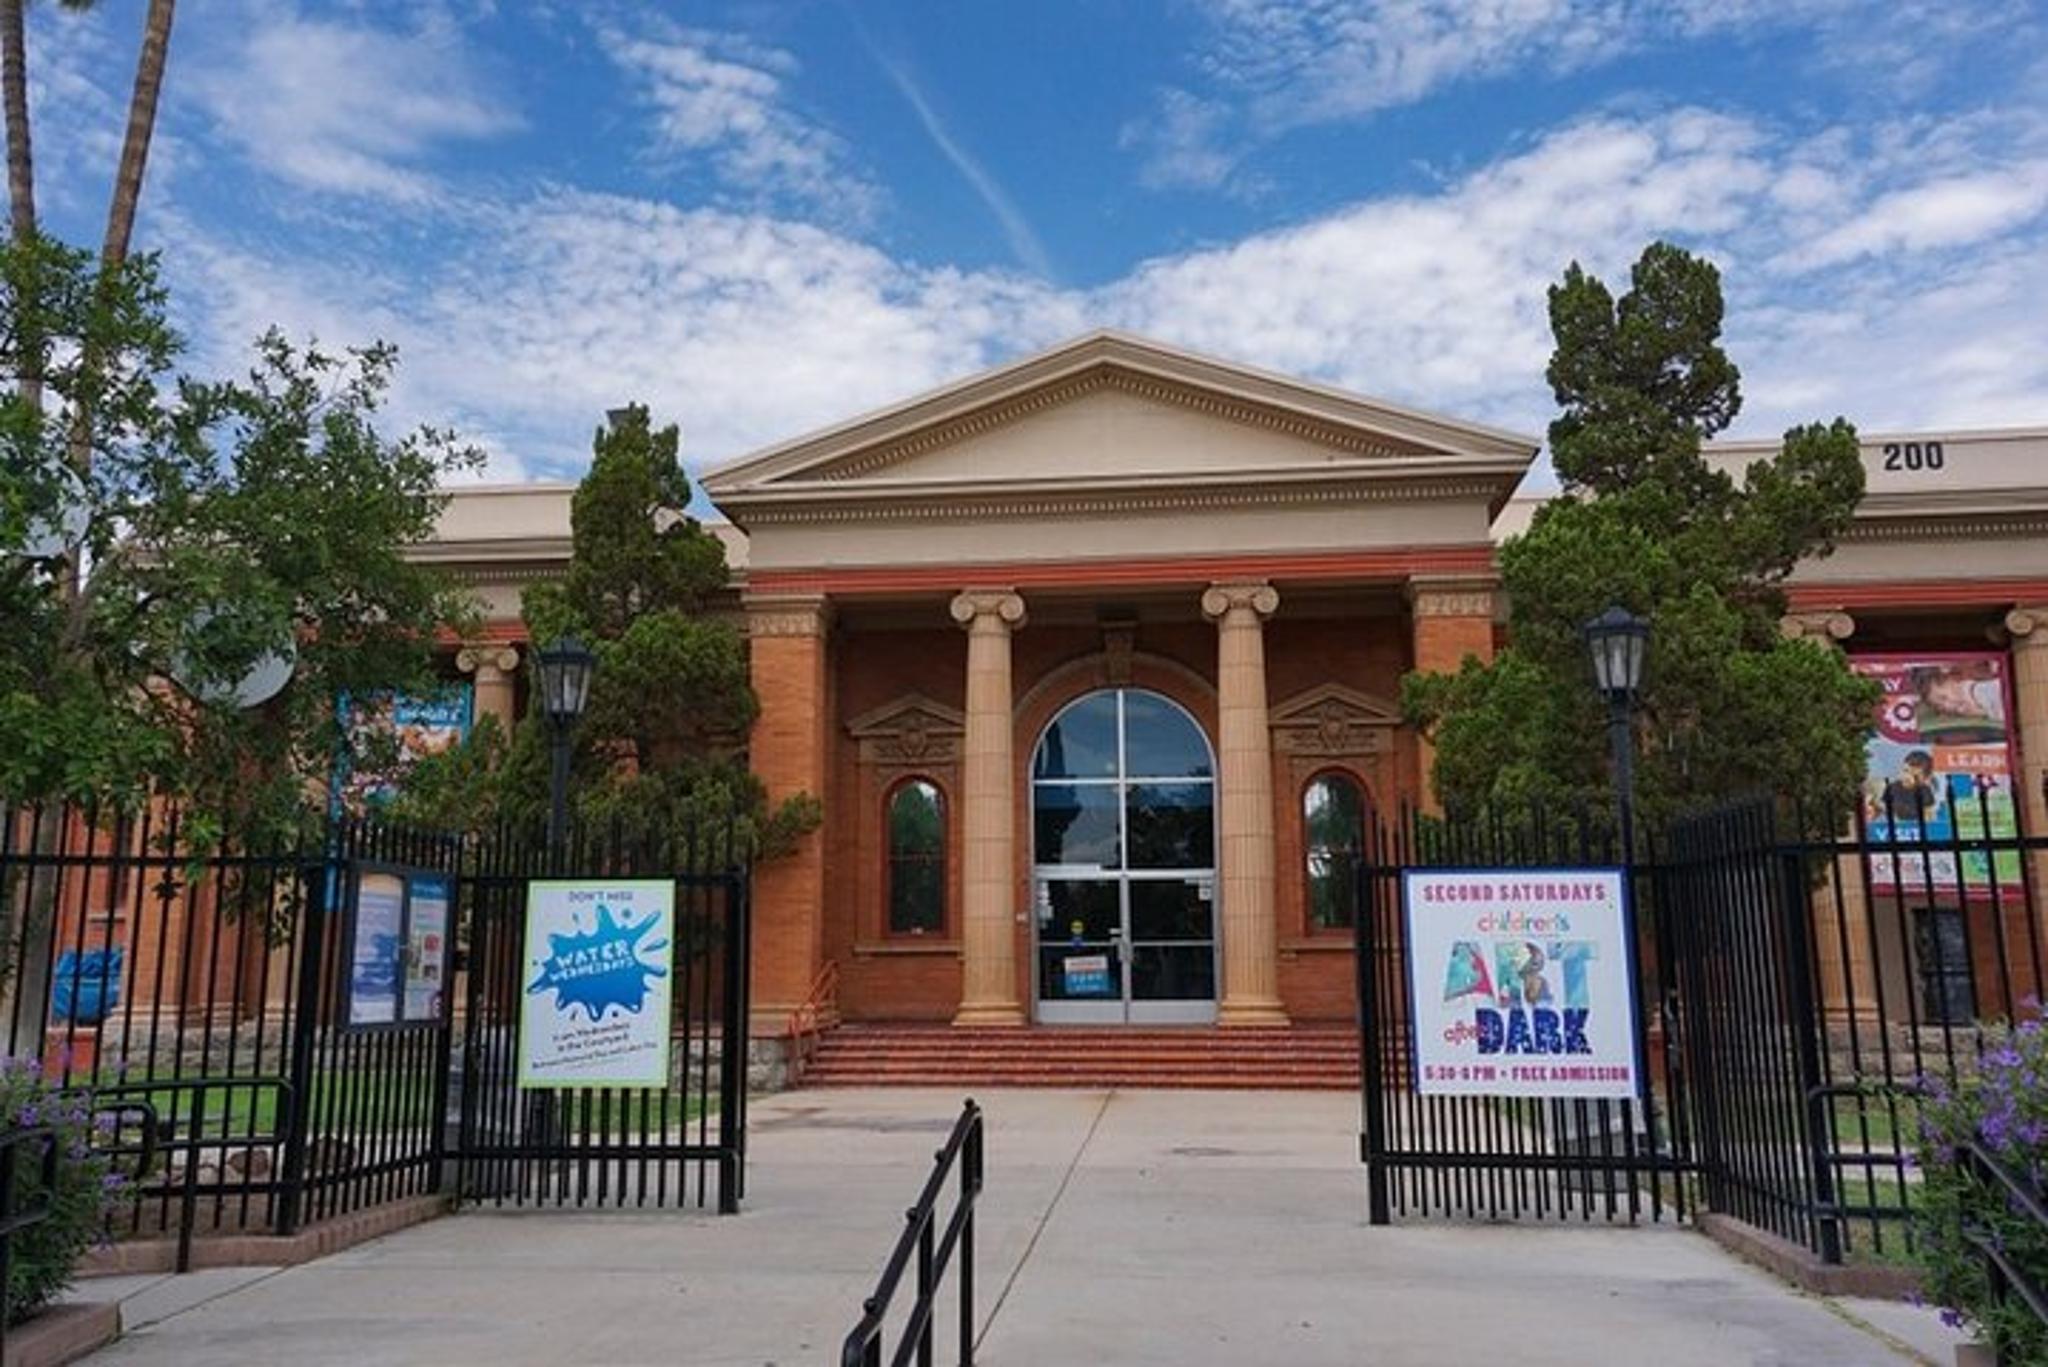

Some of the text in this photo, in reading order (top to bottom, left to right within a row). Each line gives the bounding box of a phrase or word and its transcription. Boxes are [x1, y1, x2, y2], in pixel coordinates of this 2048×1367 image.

[1884, 442, 1943, 470] 200
[1948, 754, 2006, 767] LEARN
[1875, 827, 1920, 842] VSIT
[1424, 884, 1605, 901] SECOND SATURDAYS
[555, 939, 630, 968] WATER
[1444, 941, 1597, 1003] ART
[1475, 1008, 1592, 1054] DARK
[1473, 1065, 1496, 1081] PM
[1512, 1066, 1547, 1081] FREE
[1550, 1066, 1629, 1081] ADMISSION
